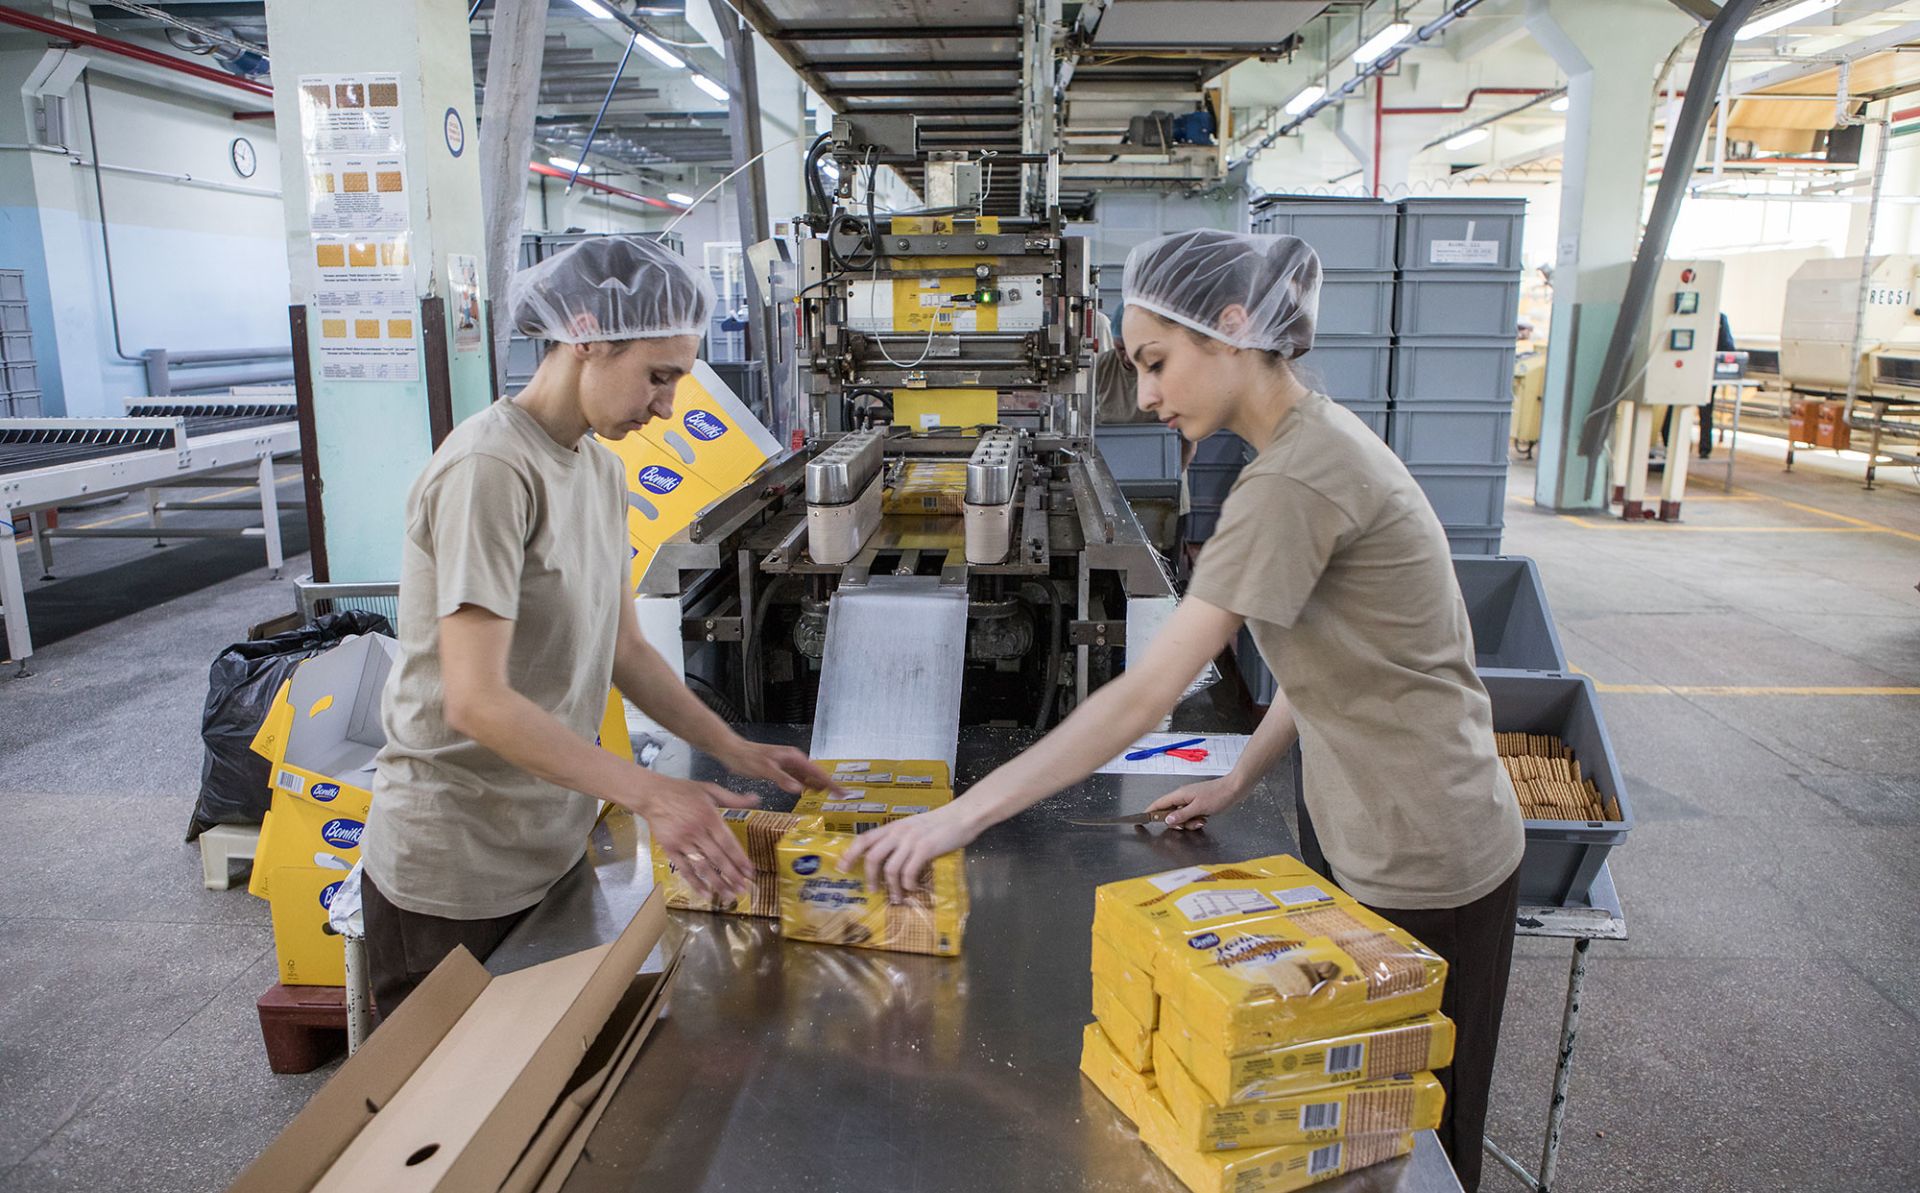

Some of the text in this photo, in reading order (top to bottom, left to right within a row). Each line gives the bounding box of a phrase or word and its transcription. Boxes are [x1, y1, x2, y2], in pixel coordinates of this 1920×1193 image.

[685, 411, 723, 439] Bonitki
[640, 466, 680, 491] Bonitki
[312, 784, 339, 798] Bonitki
